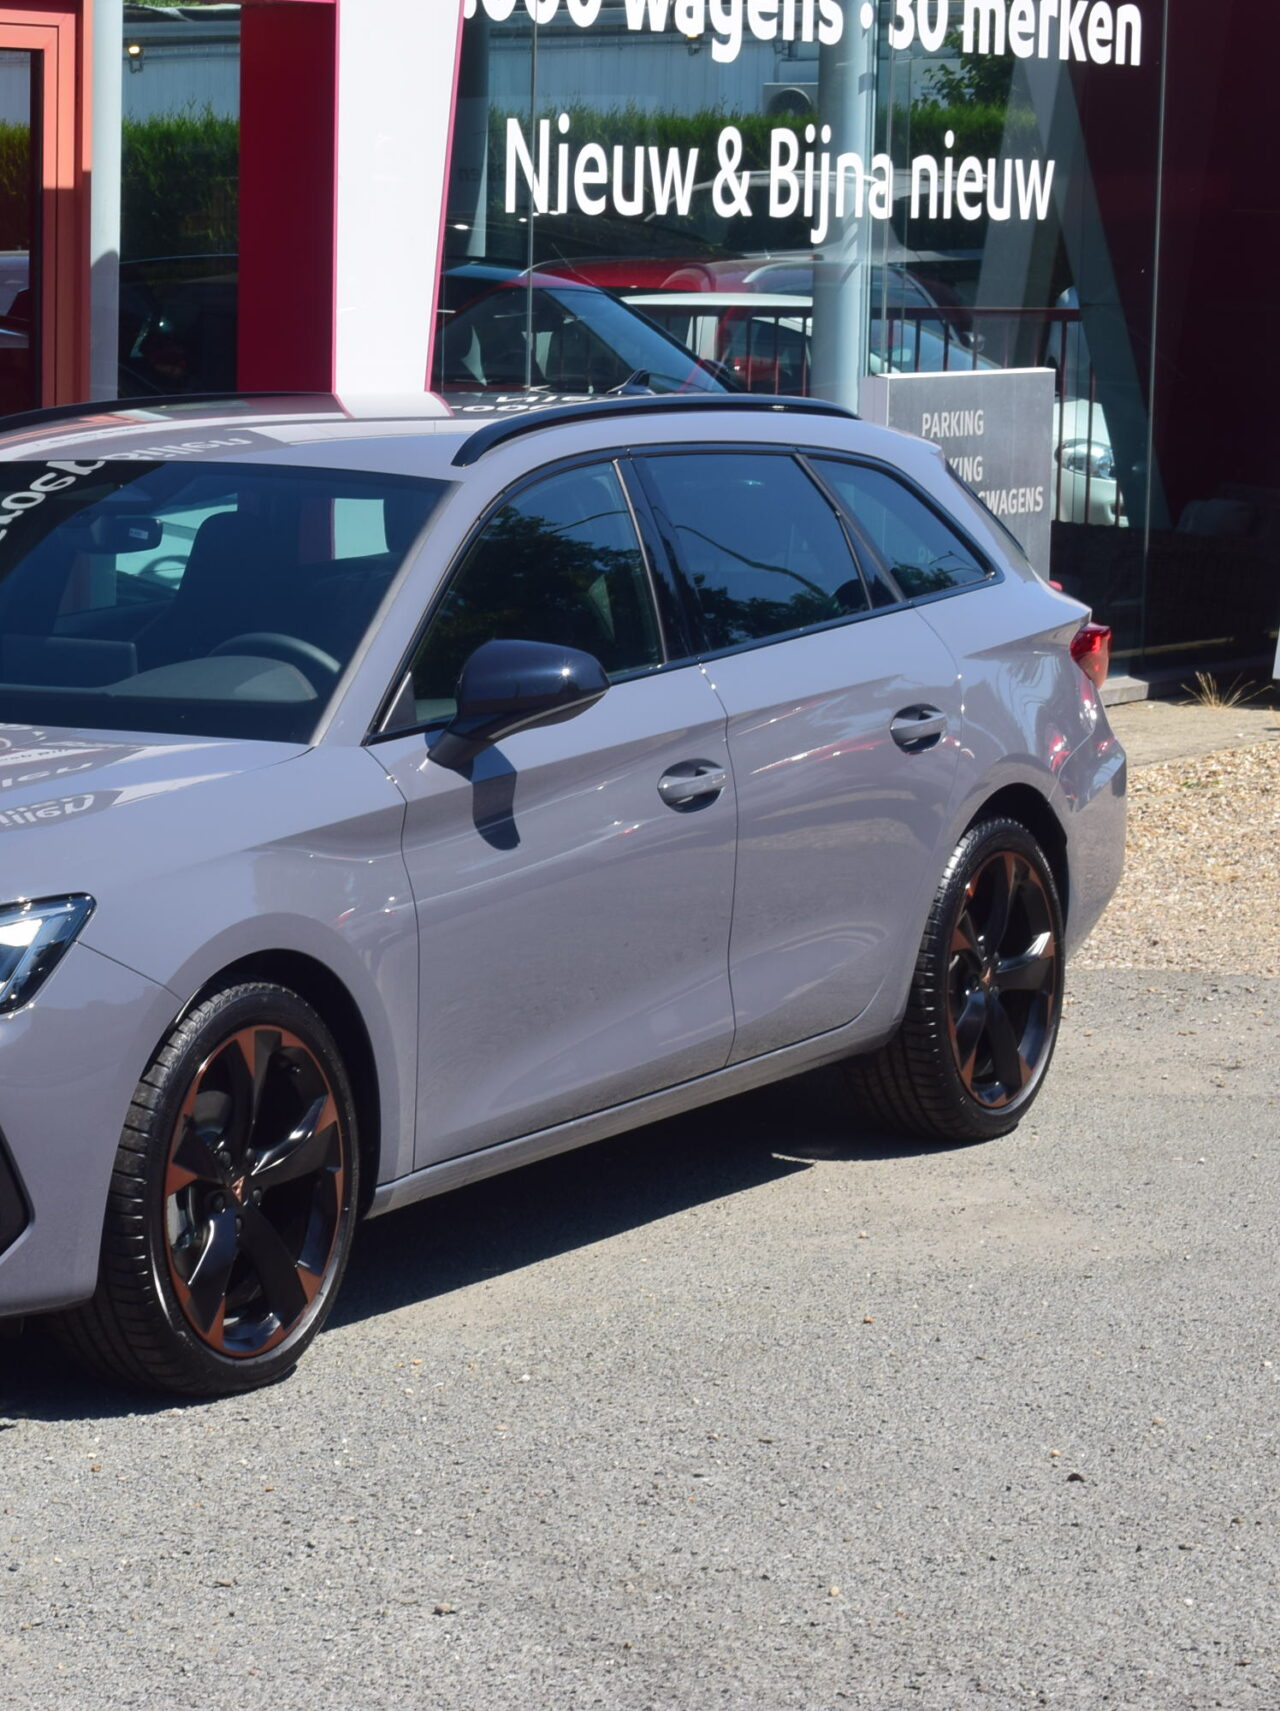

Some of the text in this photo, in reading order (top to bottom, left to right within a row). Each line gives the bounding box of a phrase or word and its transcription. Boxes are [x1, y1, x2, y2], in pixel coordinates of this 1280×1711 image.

[963, 0, 1142, 66] merken
[505, 113, 1055, 244] Nieuw & Bijna nieuw
[922, 410, 984, 438] PARKING
